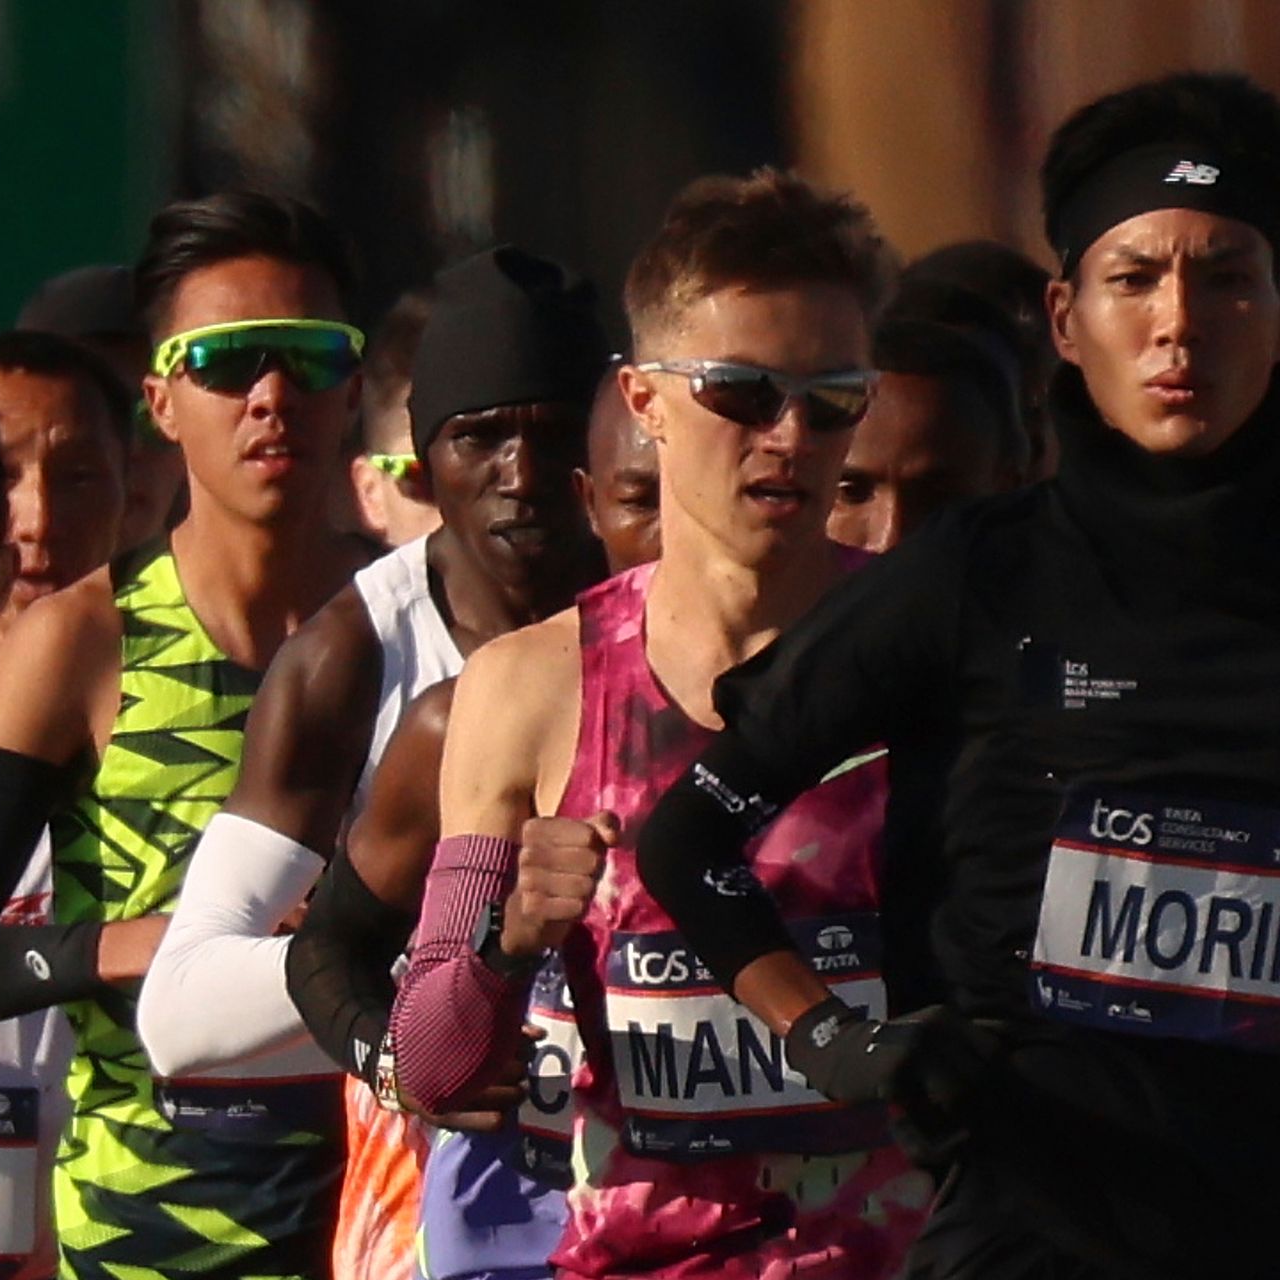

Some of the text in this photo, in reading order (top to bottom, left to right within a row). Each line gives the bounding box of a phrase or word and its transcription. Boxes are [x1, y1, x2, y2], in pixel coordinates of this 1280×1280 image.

[1089, 798, 1153, 846] tcs
[1164, 807, 1203, 822] TATA
[627, 941, 689, 984] tcs
[812, 953, 860, 971] TATA
